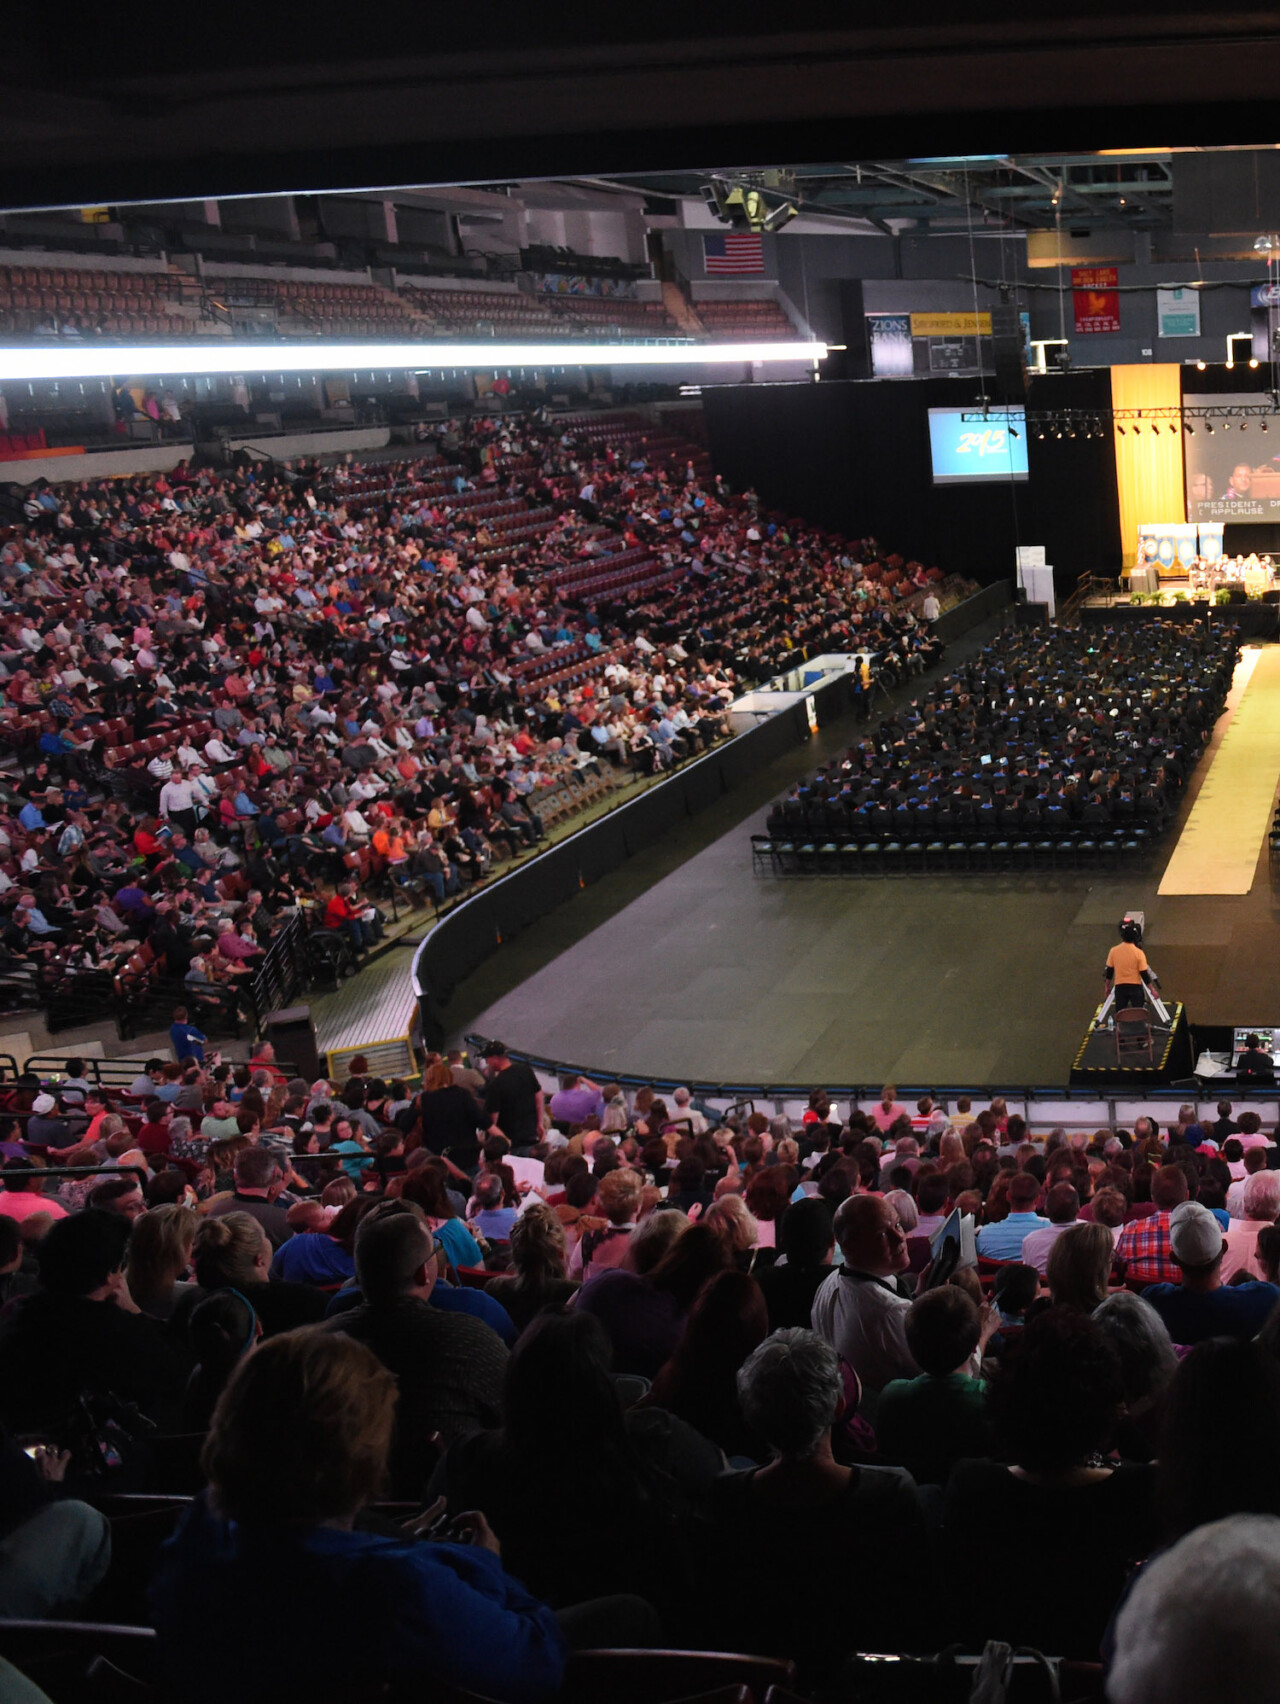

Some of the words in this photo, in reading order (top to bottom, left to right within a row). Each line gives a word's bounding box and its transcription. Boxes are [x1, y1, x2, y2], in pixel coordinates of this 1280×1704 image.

[871, 320, 908, 331] ZIONS
[956, 429, 1006, 457] 2015
[1210, 507, 1264, 515] APPLAUSE
